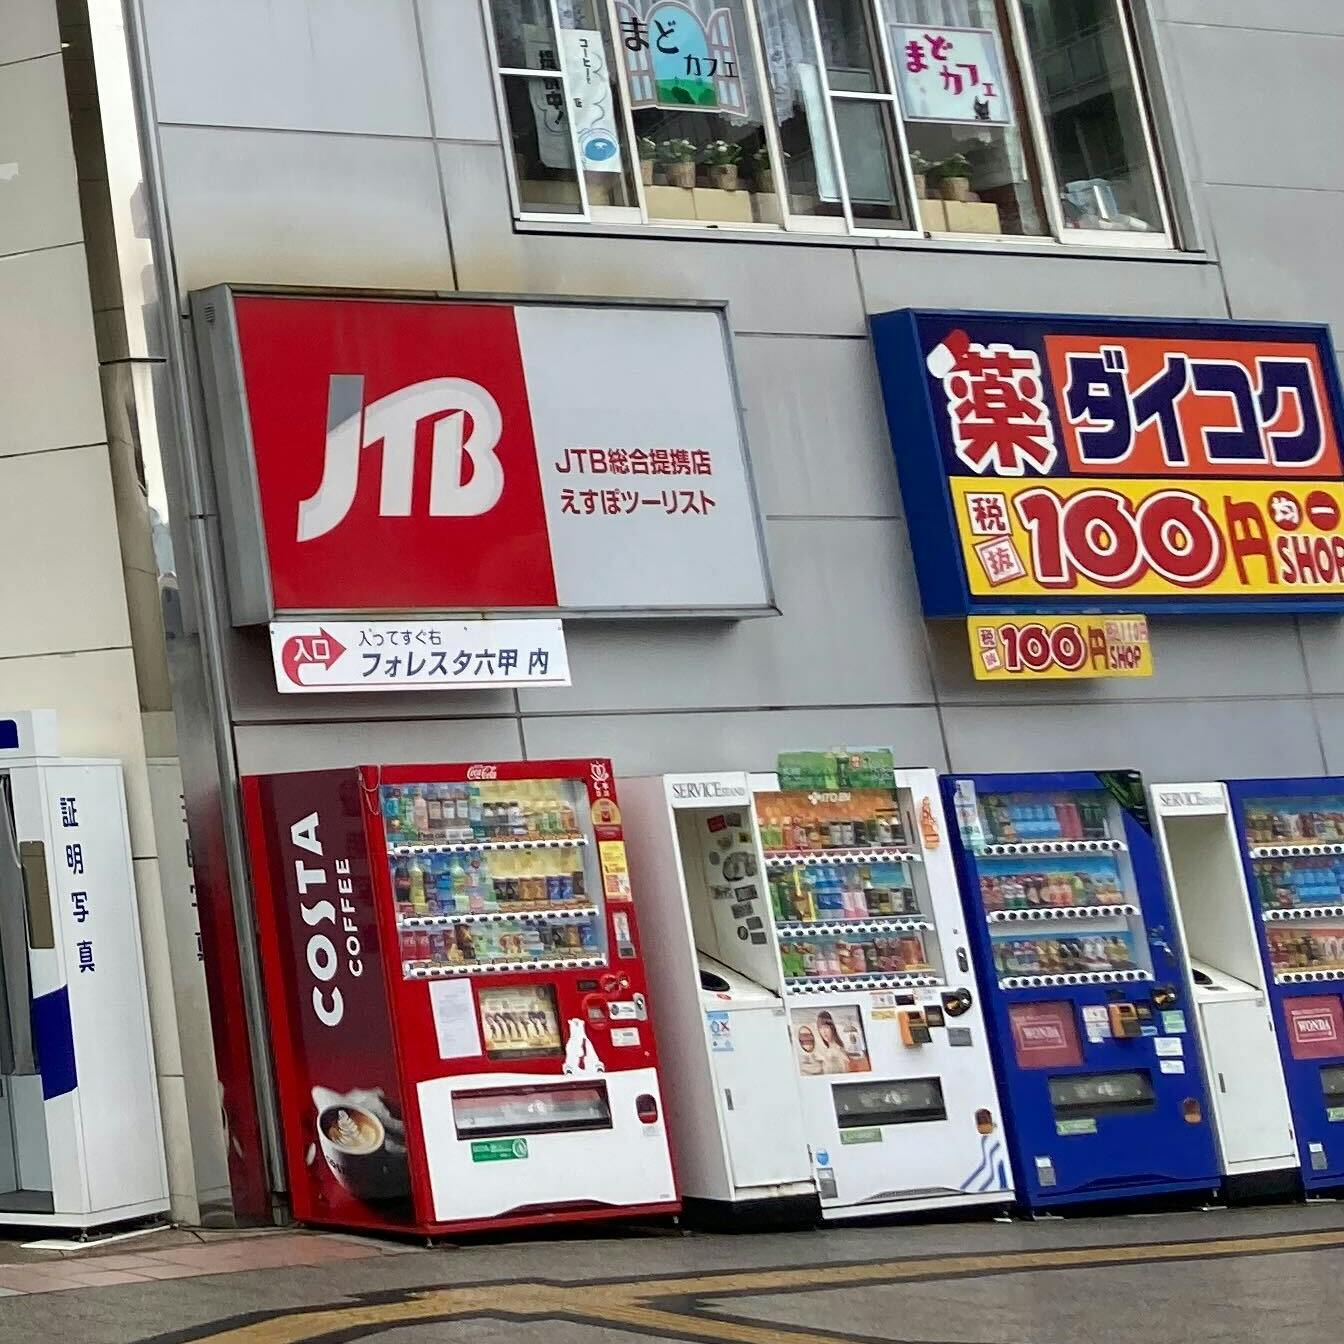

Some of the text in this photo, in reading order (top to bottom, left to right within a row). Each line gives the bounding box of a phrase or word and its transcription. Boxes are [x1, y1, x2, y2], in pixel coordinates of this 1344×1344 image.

[621, 17, 680, 54] まど
[683, 54, 739, 78] カフェ
[905, 33, 954, 74] まど
[941, 63, 997, 97] カフェ
[944, 342, 1057, 476] 薬
[1063, 345, 1325, 468] ダイコク
[297, 374, 505, 542] JTB
[555, 448, 712, 475] JTB総合提携店
[561, 488, 716, 515] えすぽツーリスト
[294, 639, 330, 662] 入口
[359, 629, 442, 647] 入ってすぐ右
[362, 648, 549, 677] フォレスタ六甲 内
[1109, 645, 1142, 669] SHOP
[672, 782, 721, 798] SERVICE
[60, 797, 95, 973] 証明写真
[290, 812, 344, 1027] COSTA
[335, 858, 363, 977] COFFEE
